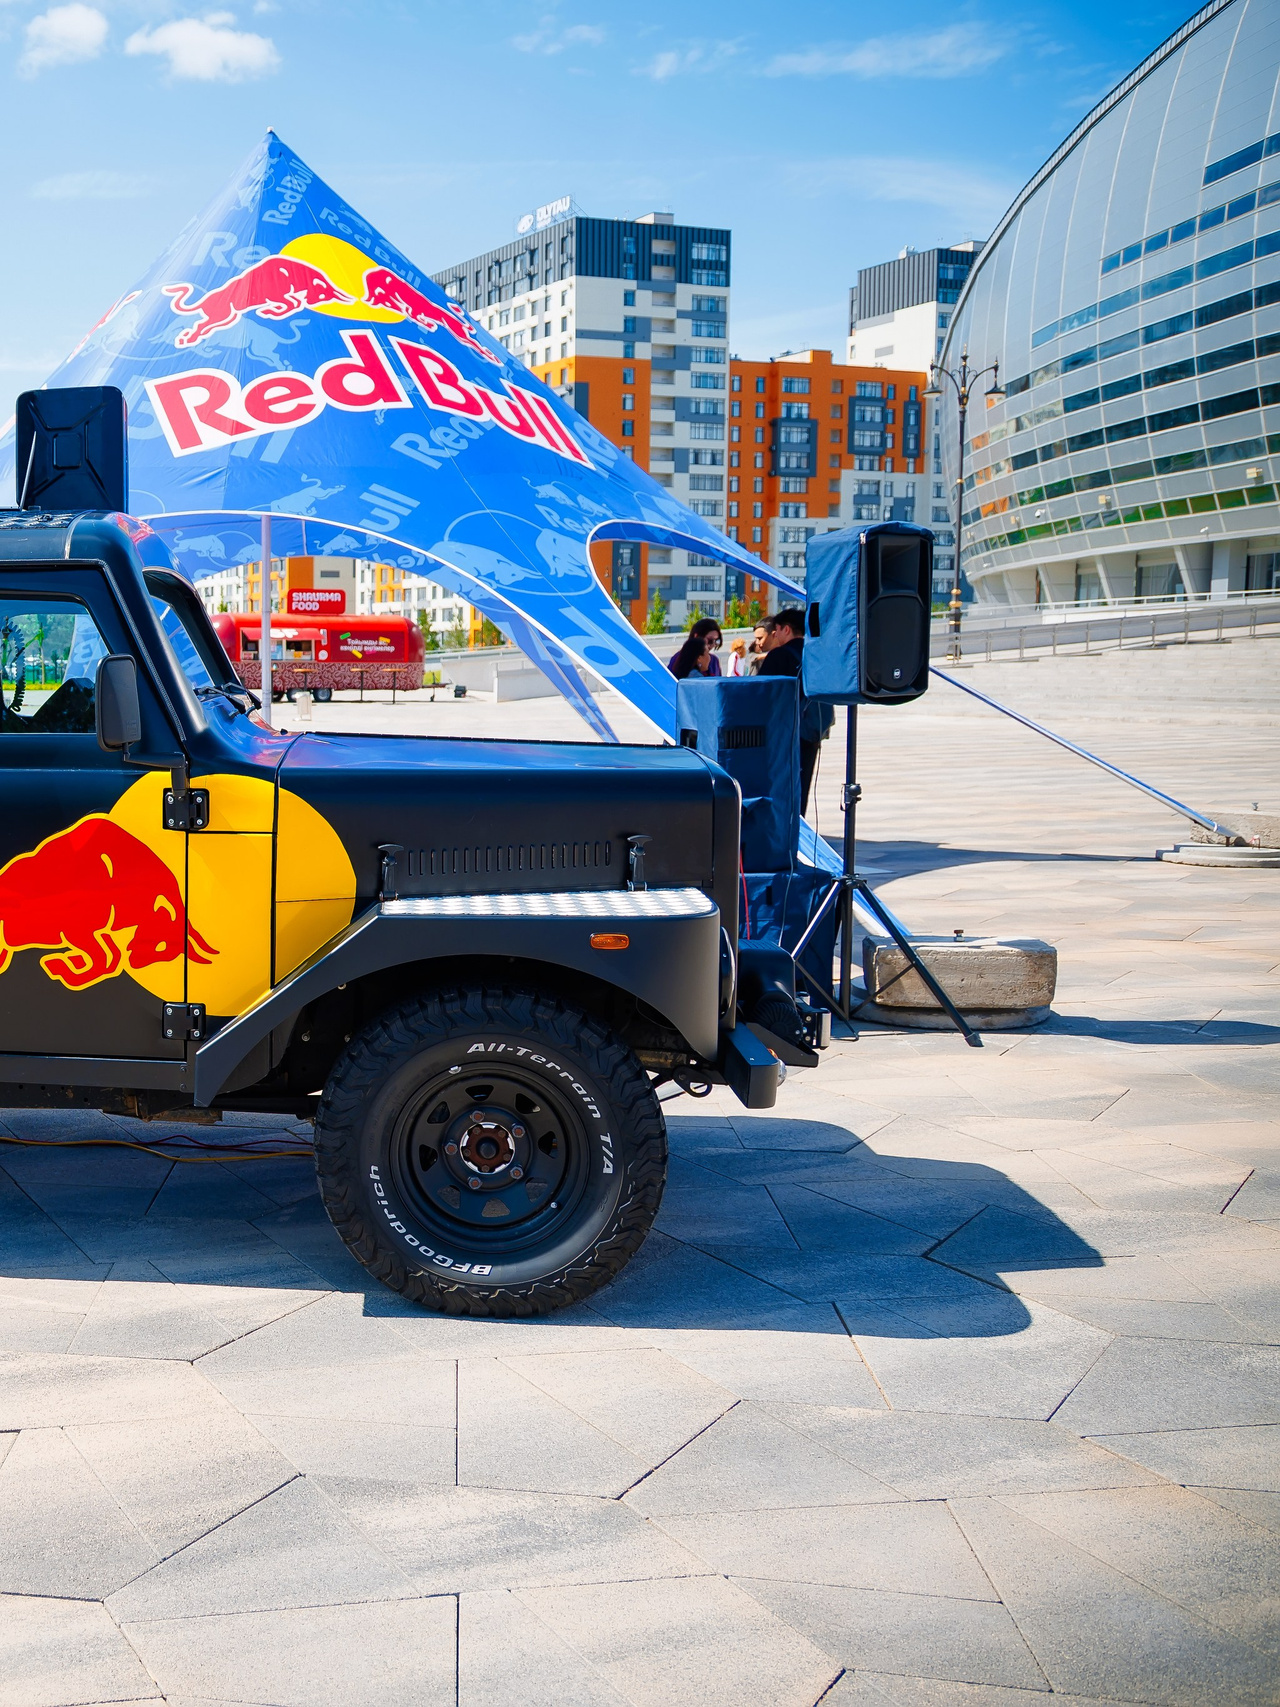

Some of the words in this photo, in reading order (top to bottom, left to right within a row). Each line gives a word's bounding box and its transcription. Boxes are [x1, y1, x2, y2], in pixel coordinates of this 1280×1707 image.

[261, 186, 303, 226] Red
[191, 231, 271, 270] Re
[320, 207, 371, 249] Red
[374, 245, 421, 289] Bull
[149, 331, 408, 453] Red
[392, 337, 592, 467] Bull
[292, 591, 342, 602] SHAURMA
[292, 602, 320, 611] FOOD
[466, 1042, 602, 1120] All-Terrain
[599, 1132, 615, 1175] T/A
[369, 1164, 494, 1277] BFGoodrich
